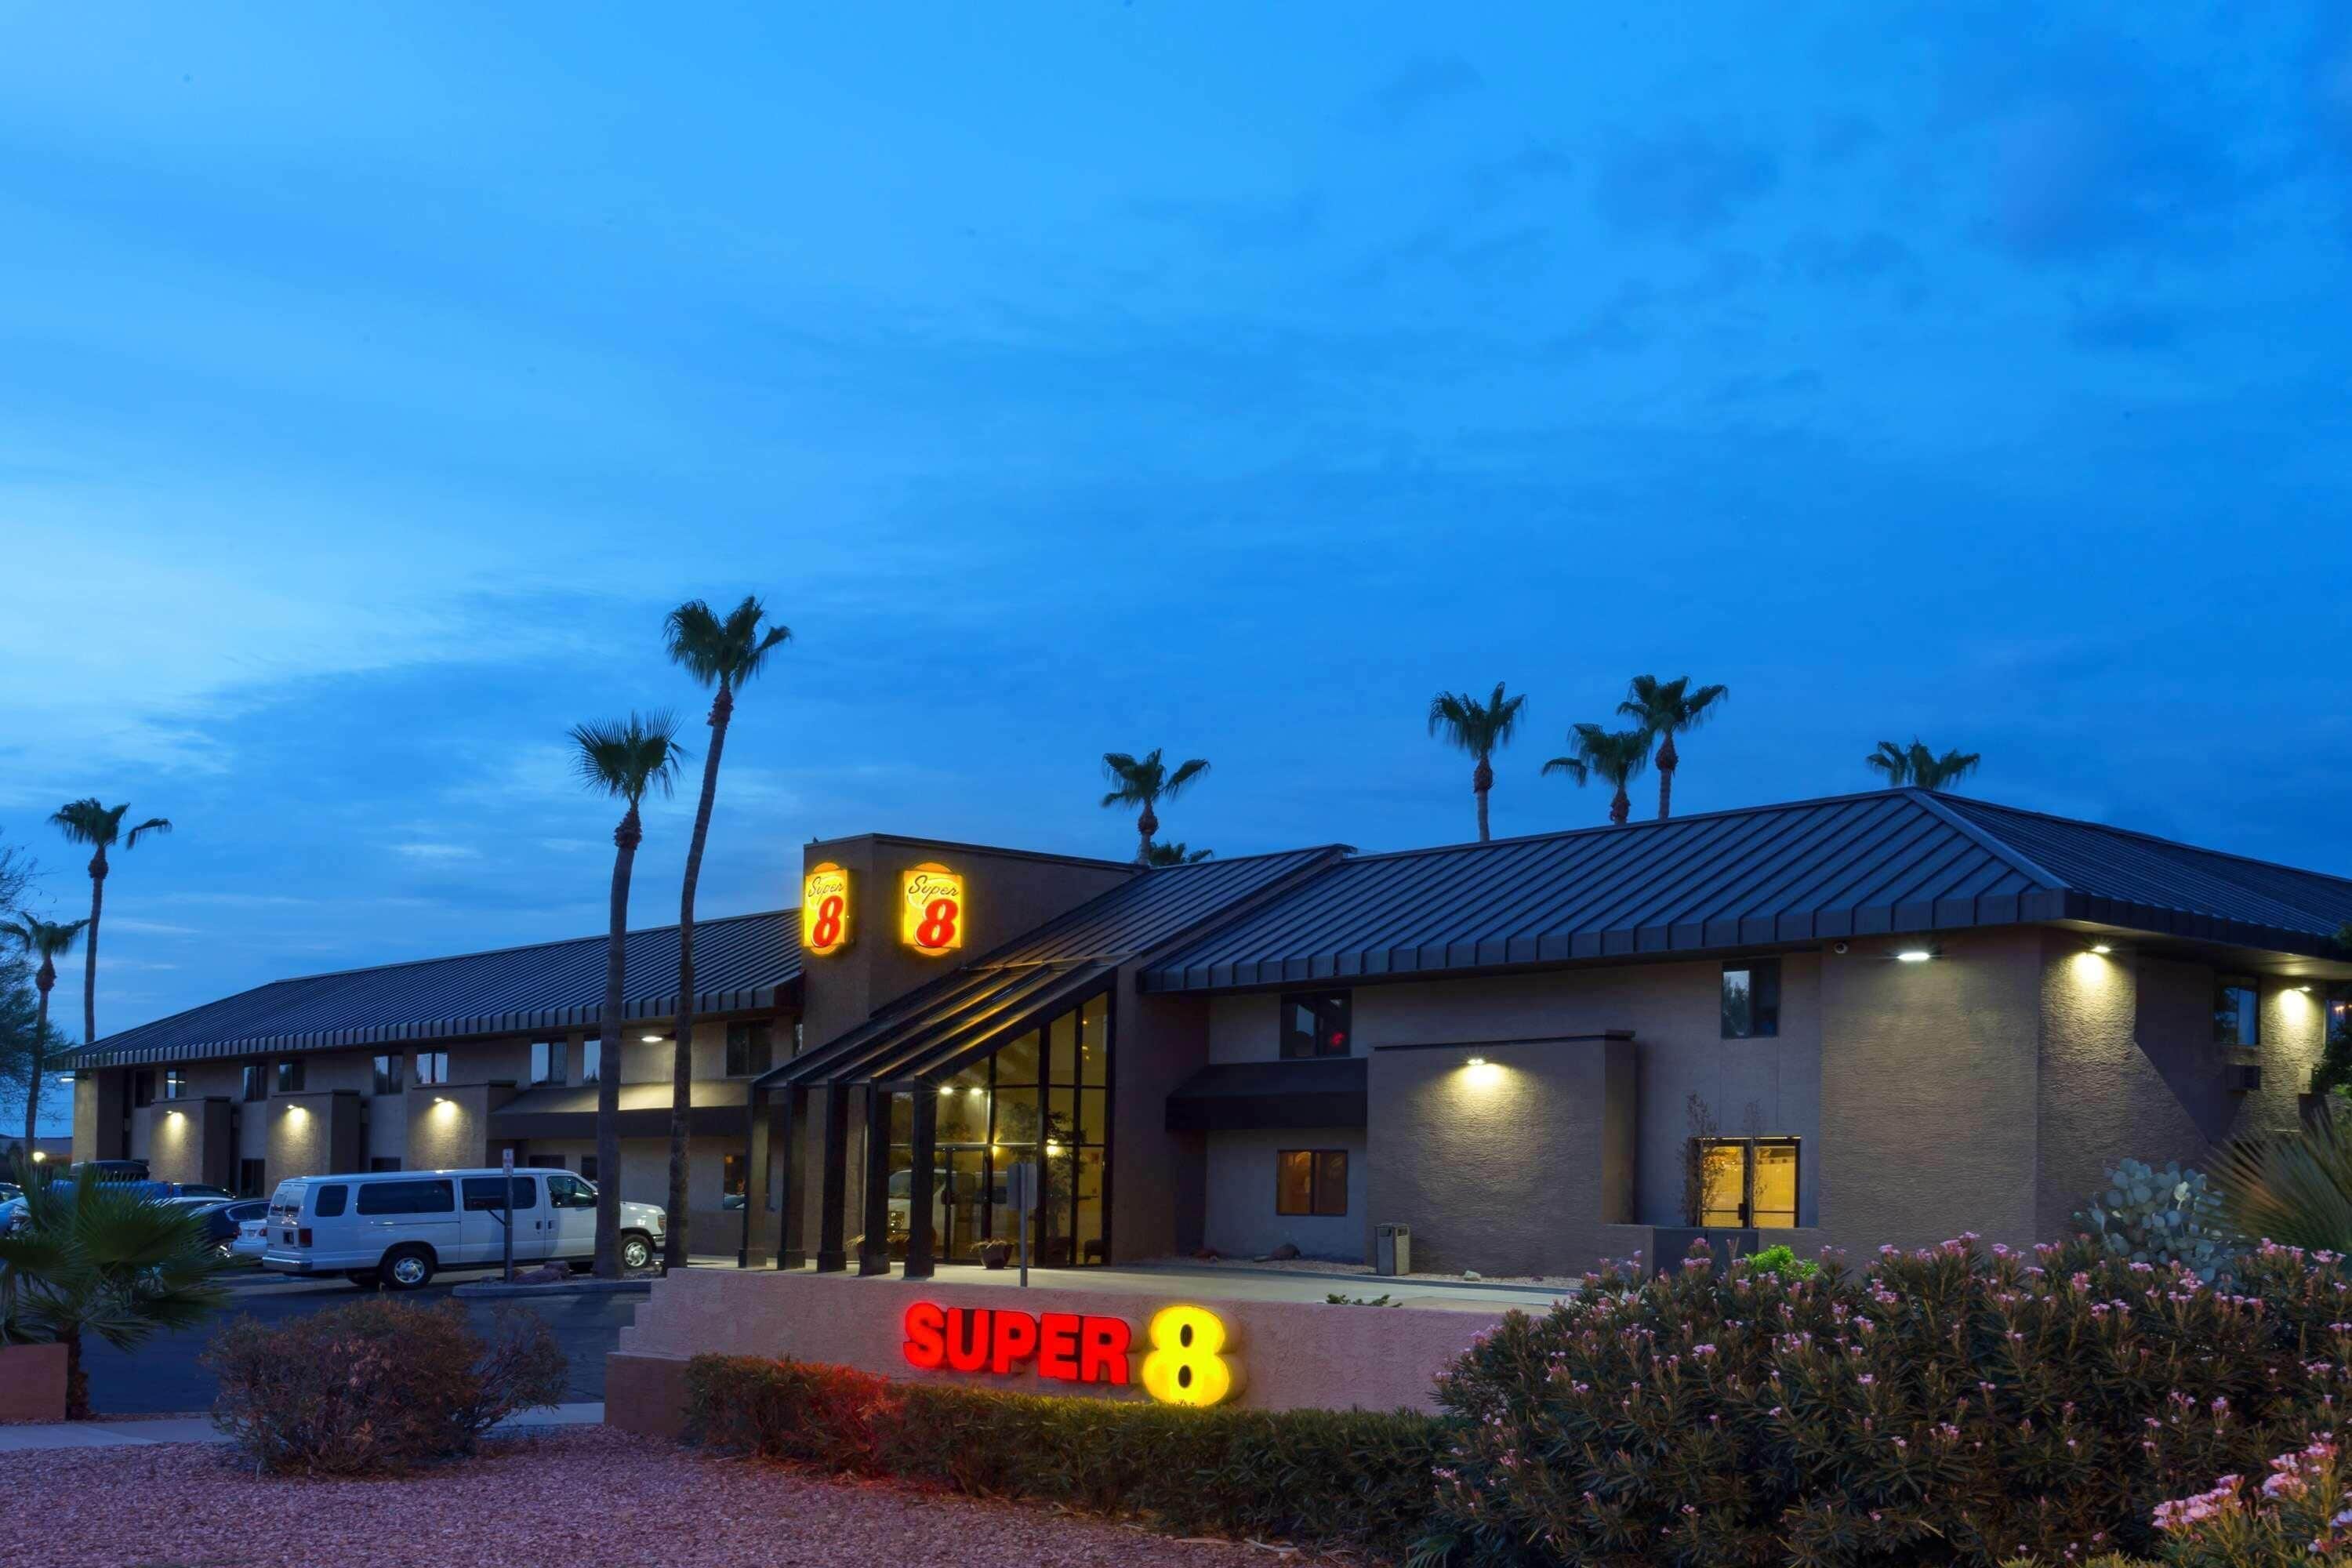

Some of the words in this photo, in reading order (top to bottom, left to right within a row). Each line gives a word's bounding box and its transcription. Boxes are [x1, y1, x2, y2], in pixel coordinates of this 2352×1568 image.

[808, 877, 844, 905] Super
[909, 875, 959, 905] Super
[811, 895, 844, 948] 8
[914, 898, 959, 948] 8
[902, 1302, 1131, 1385] SUPER
[1142, 1305, 1230, 1406] 8
